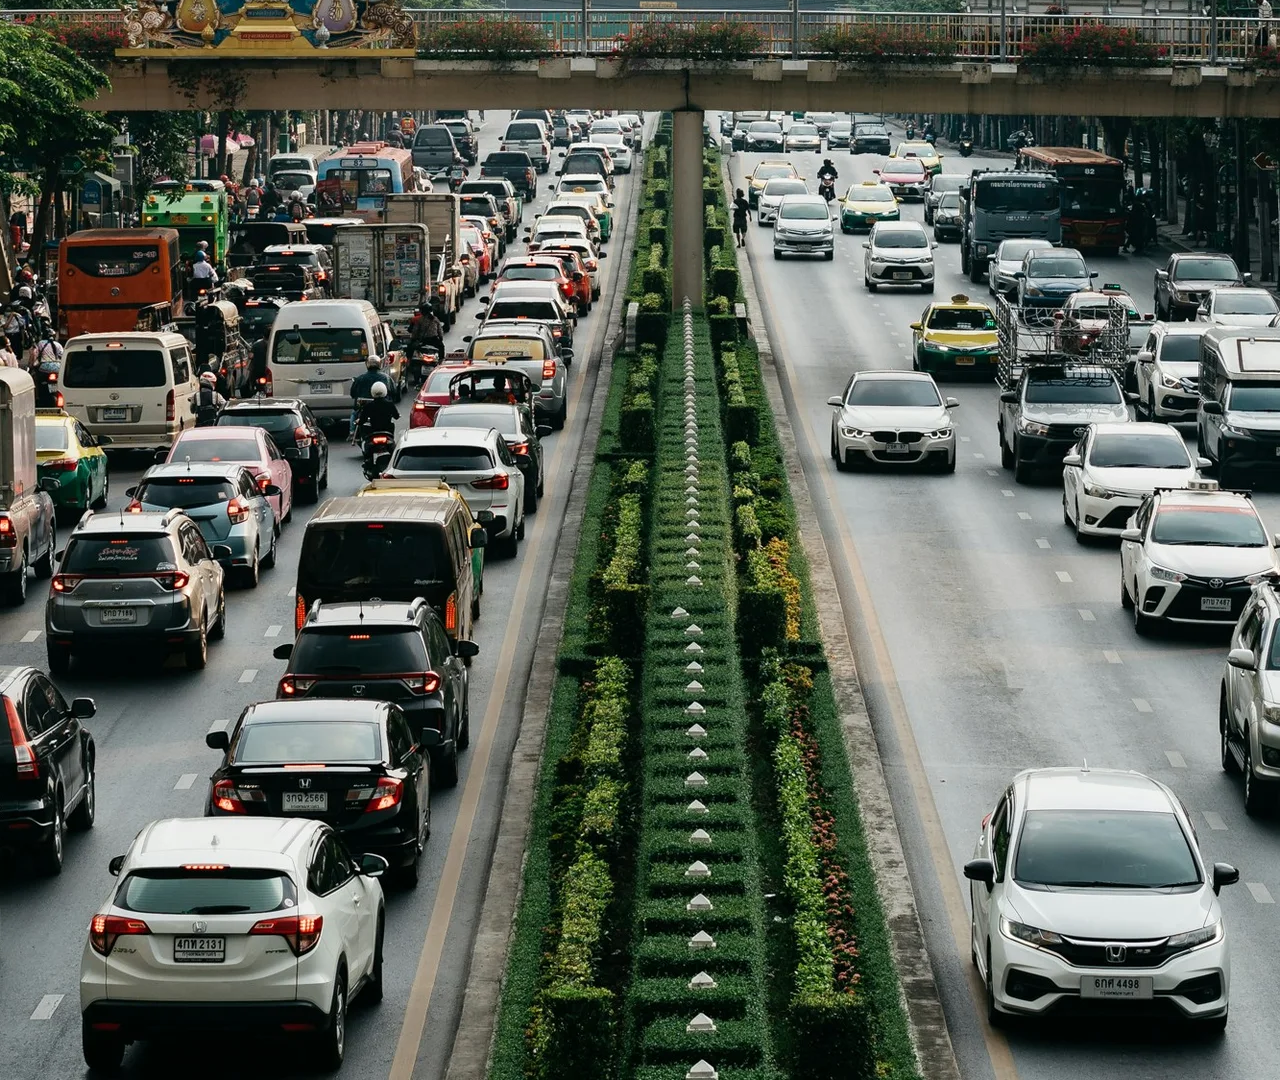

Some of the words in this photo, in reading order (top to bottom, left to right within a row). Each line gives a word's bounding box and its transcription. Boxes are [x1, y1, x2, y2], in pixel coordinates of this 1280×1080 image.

[305, 794, 325, 803] 2566
[199, 937, 222, 949] 2131
[1117, 978, 1139, 988] 4498
